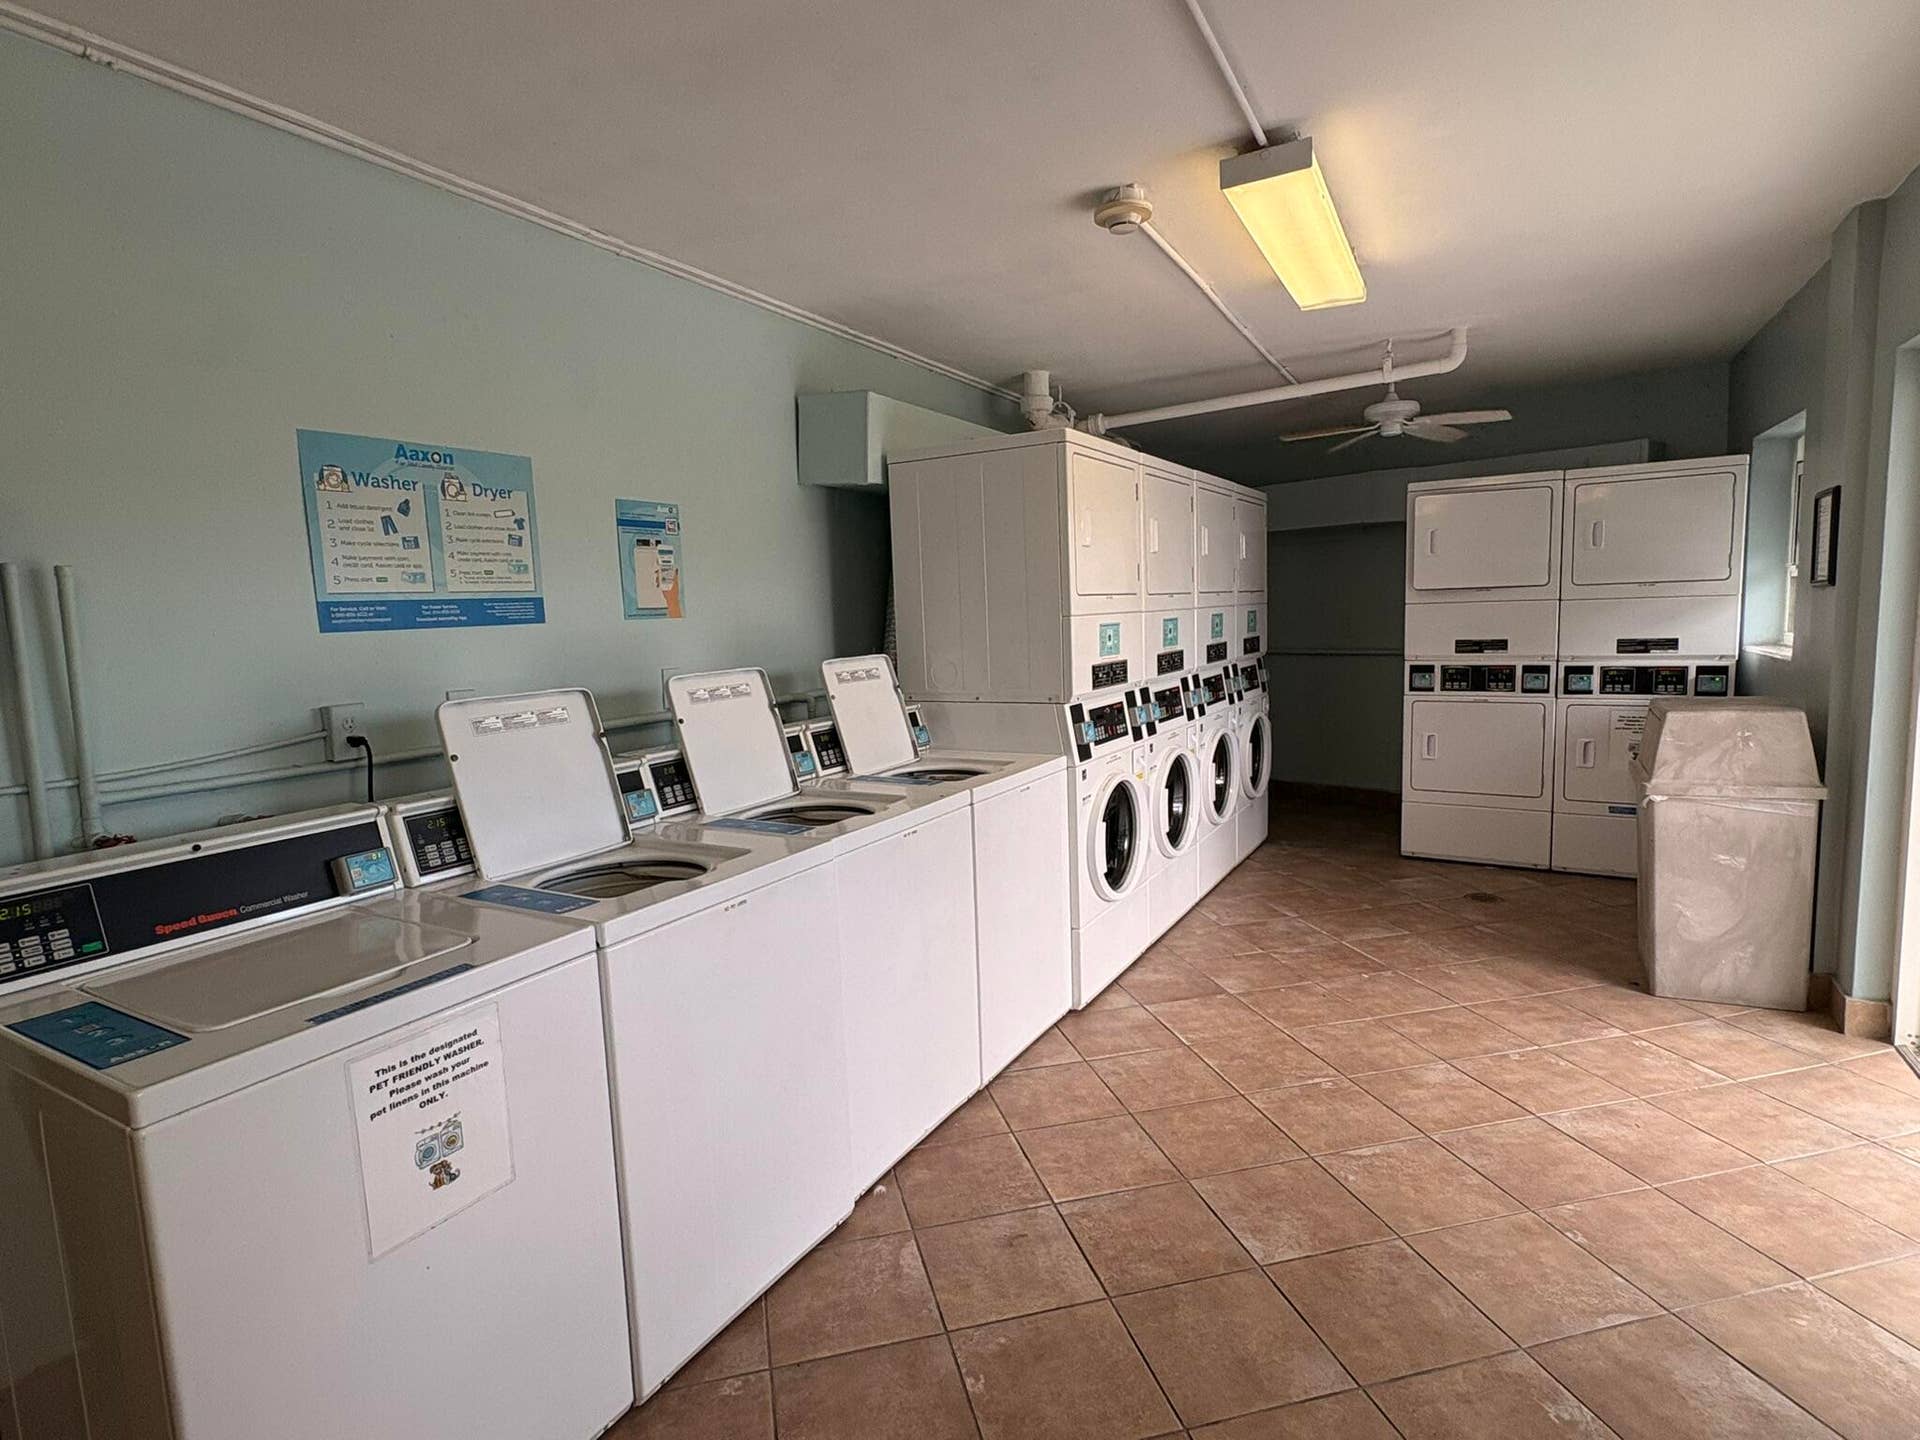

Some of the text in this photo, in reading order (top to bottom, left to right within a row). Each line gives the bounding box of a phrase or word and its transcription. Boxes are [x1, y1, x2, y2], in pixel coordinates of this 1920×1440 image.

[394, 443, 454, 465] Aaxon
[351, 471, 418, 491] Washer
[472, 483, 513, 501] Dryer
[327, 519, 336, 529] 2
[445, 521, 452, 531] 2
[329, 538, 337, 548] 3
[357, 540, 372, 548] cycle
[331, 557, 339, 567] 4
[333, 575, 341, 585] 5
[450, 569, 457, 578] 5
[154, 891, 309, 935] Speed Queen Commercial Washer
[374, 1028, 478, 1078] This is the designated
[369, 1039, 485, 1094] PET FRIENDLY WASHER.
[389, 1057, 471, 1098] Please wash your
[370, 1061, 489, 1122] pet linens in this machine
[419, 1091, 449, 1109] ONLY.
